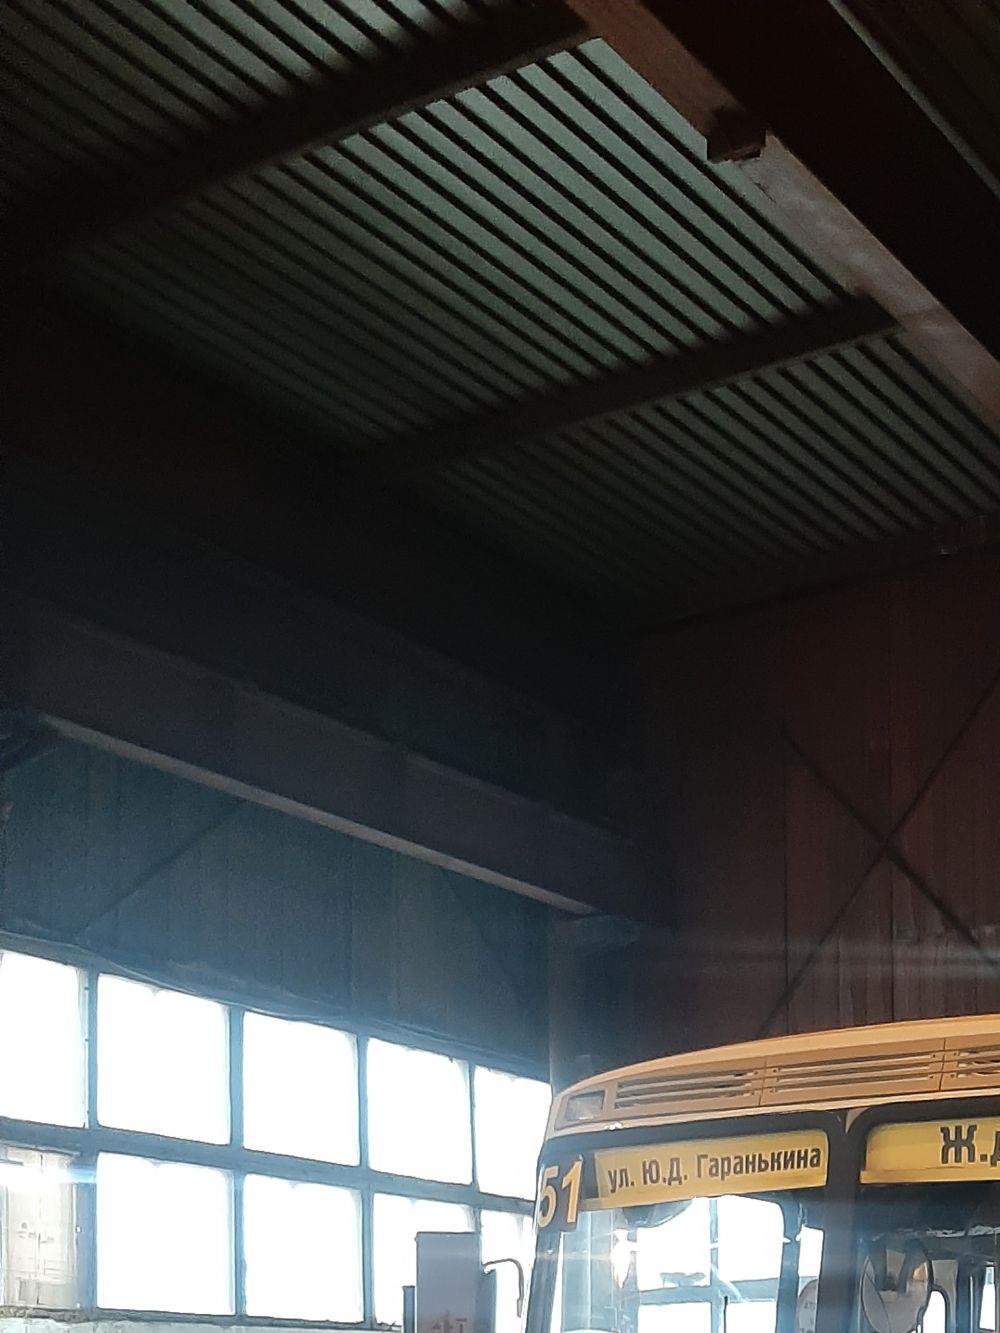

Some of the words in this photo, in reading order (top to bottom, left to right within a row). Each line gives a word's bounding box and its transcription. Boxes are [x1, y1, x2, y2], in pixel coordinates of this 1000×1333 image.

[537, 1154, 584, 1228] 51
[607, 1165, 636, 1194] ул.
[642, 1160, 688, 1187] Ю.Д.
[696, 1146, 822, 1181] Гаранькина
